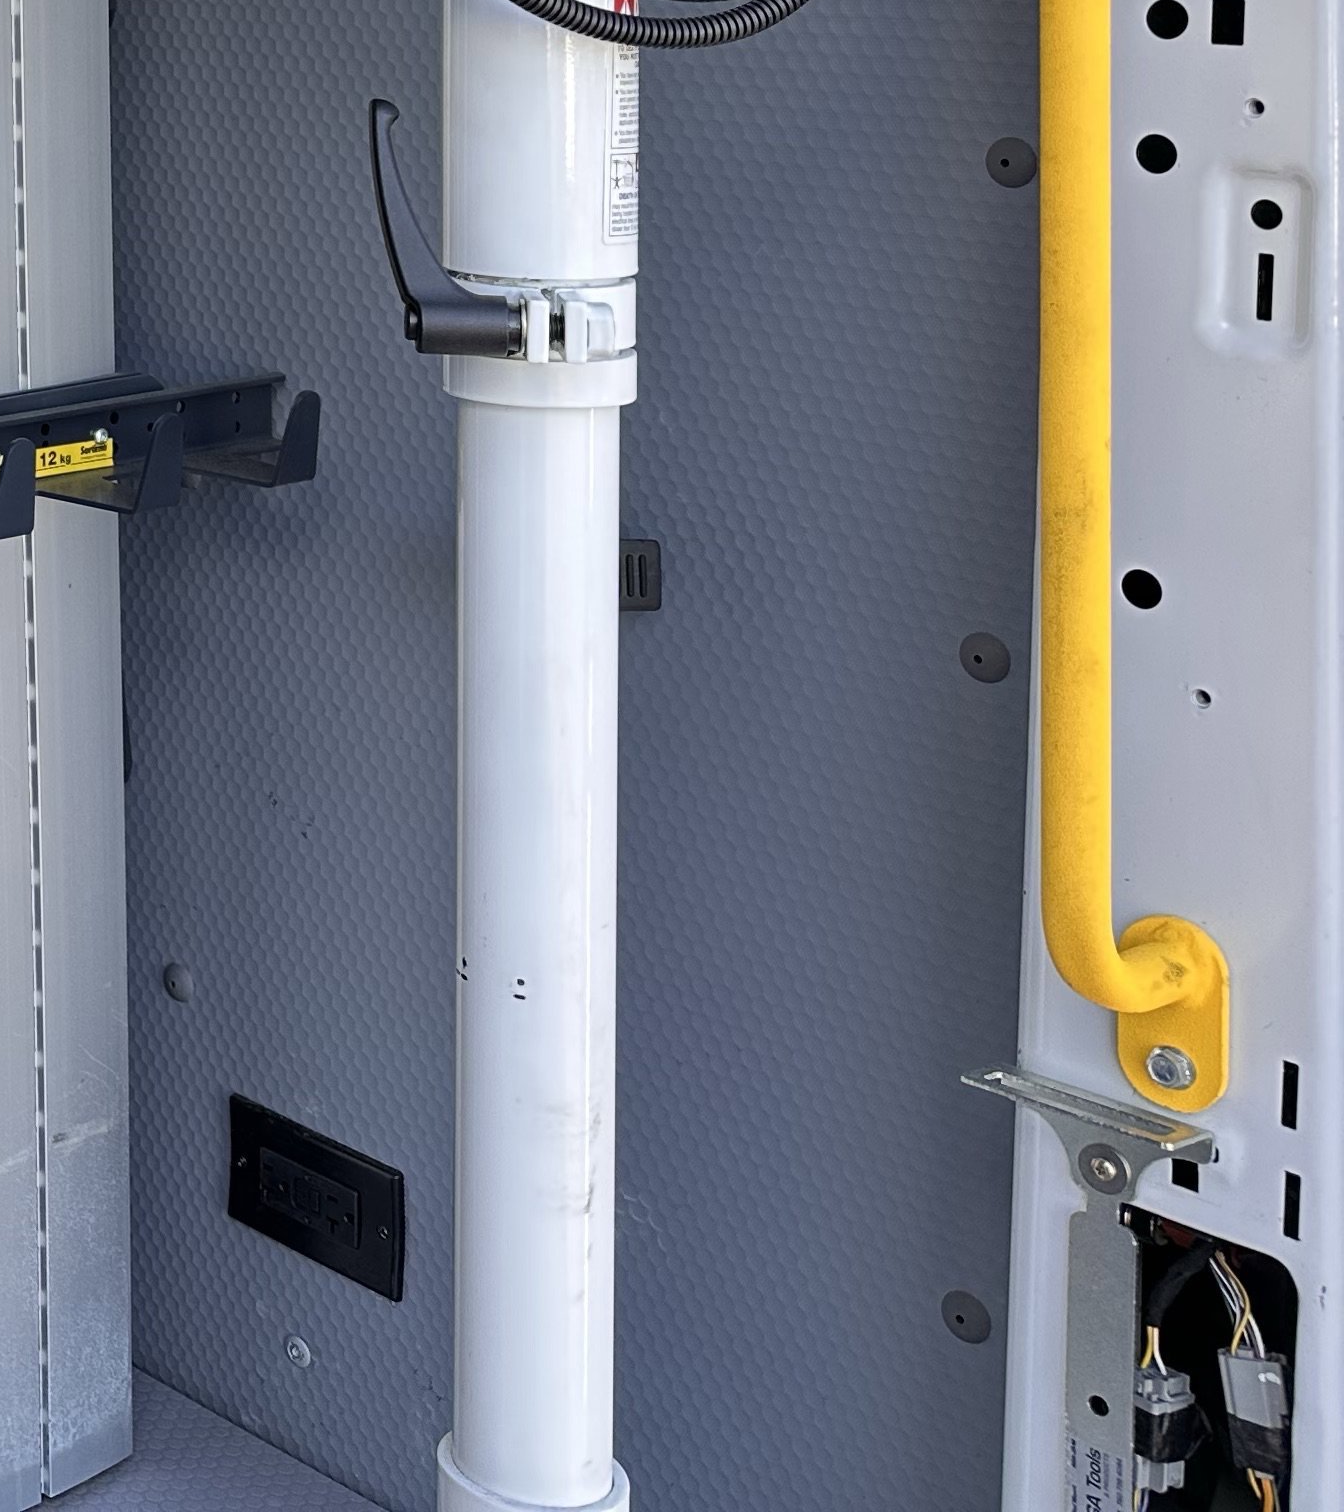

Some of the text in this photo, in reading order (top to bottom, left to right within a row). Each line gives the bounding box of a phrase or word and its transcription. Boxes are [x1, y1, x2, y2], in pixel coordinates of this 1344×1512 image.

[39, 450, 57, 467] 12
[59, 453, 72, 466] kg
[1085, 1447, 1102, 1491] Tools
